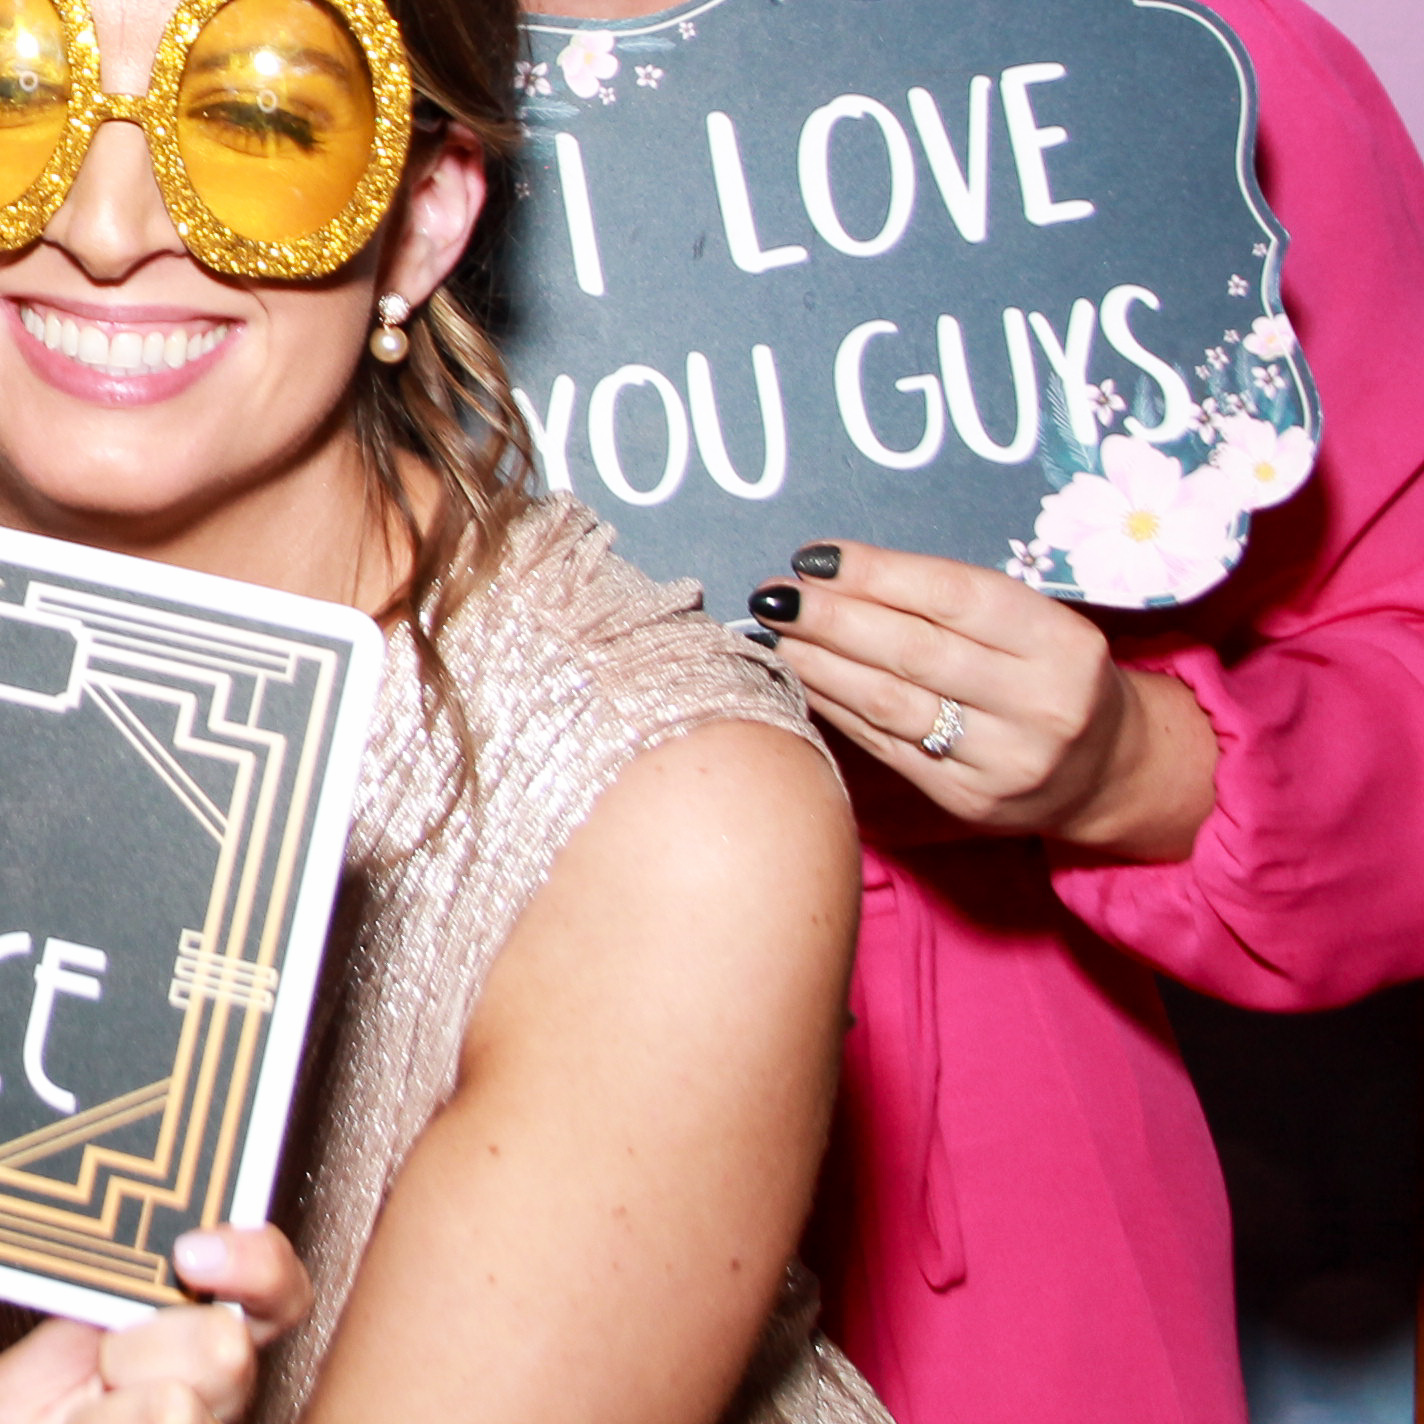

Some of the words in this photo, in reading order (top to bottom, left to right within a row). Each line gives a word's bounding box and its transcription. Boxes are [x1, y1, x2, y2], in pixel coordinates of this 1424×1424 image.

[555, 133, 604, 296] I
[706, 62, 1095, 273] LOVE
[510, 344, 786, 505] YOU
[834, 284, 1193, 469] GUYS
